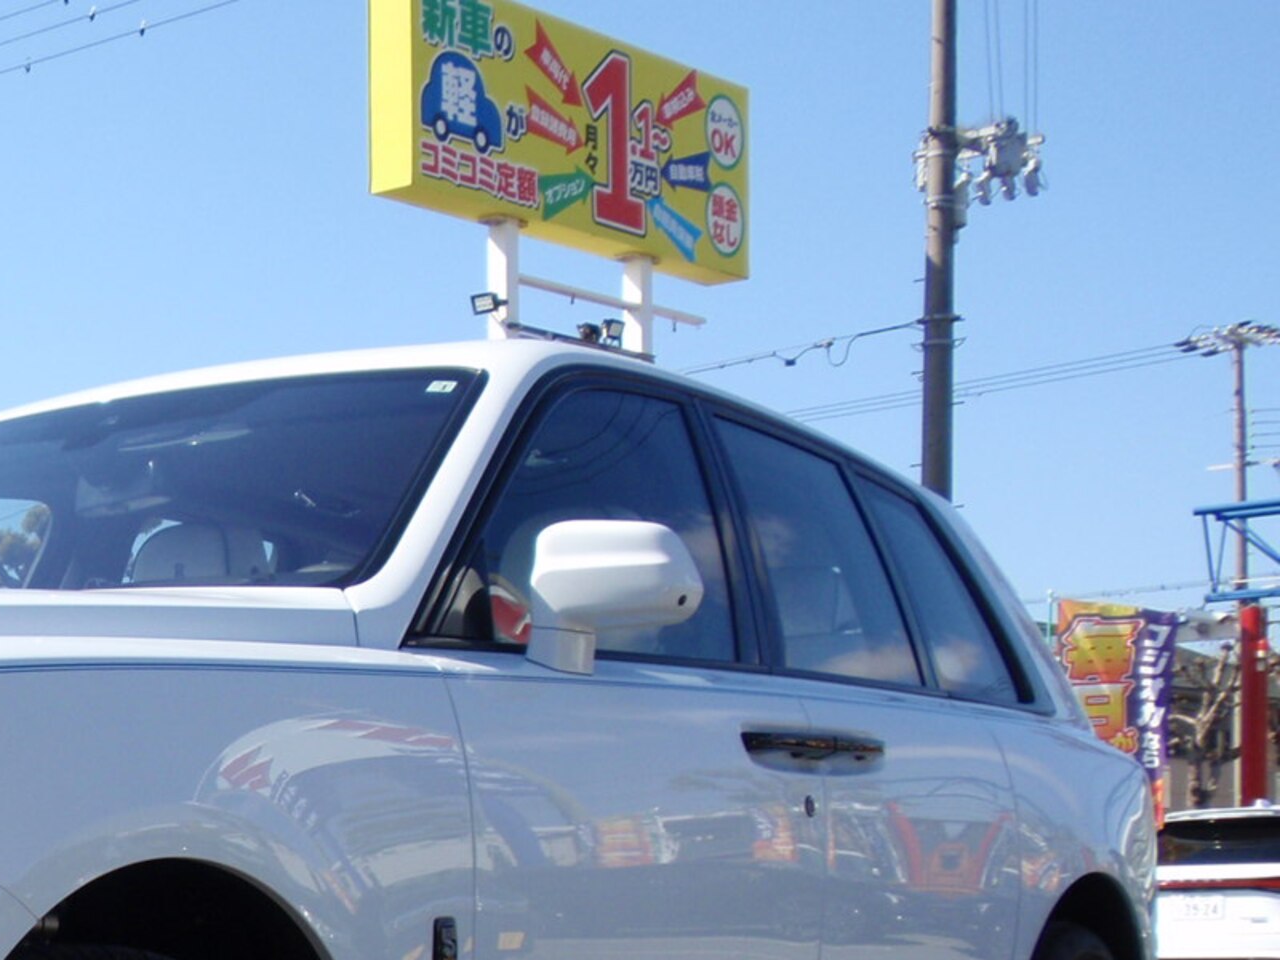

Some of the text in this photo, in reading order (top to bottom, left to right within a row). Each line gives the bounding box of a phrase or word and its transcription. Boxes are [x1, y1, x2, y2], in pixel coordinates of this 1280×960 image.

[710, 126, 738, 159] OK
[420, 140, 539, 207] コミコミ定額
